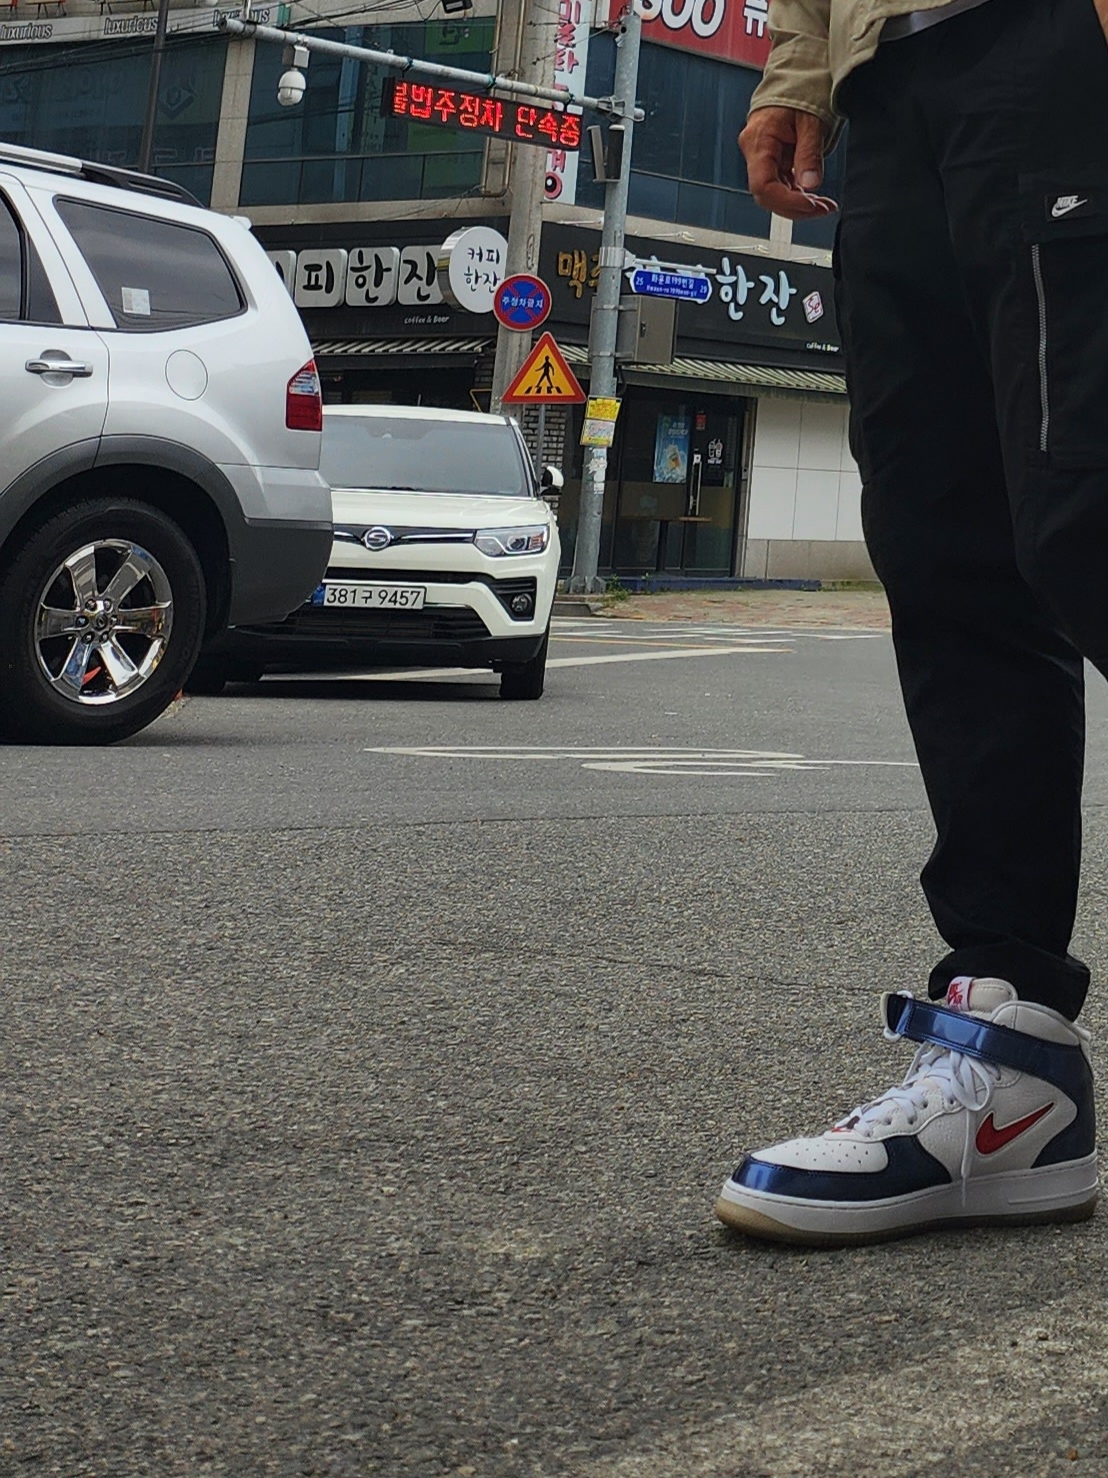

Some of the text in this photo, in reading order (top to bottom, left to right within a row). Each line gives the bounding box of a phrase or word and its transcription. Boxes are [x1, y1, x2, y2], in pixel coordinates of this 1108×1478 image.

[515, 105, 582, 149] 단속중
[467, 248, 501, 265] 커피
[276, 249, 443, 303] 피한잔
[464, 266, 502, 295] 한잔
[502, 294, 545, 310] 주정차금지
[327, 588, 373, 605] 381구
[378, 589, 421, 607] 9457
